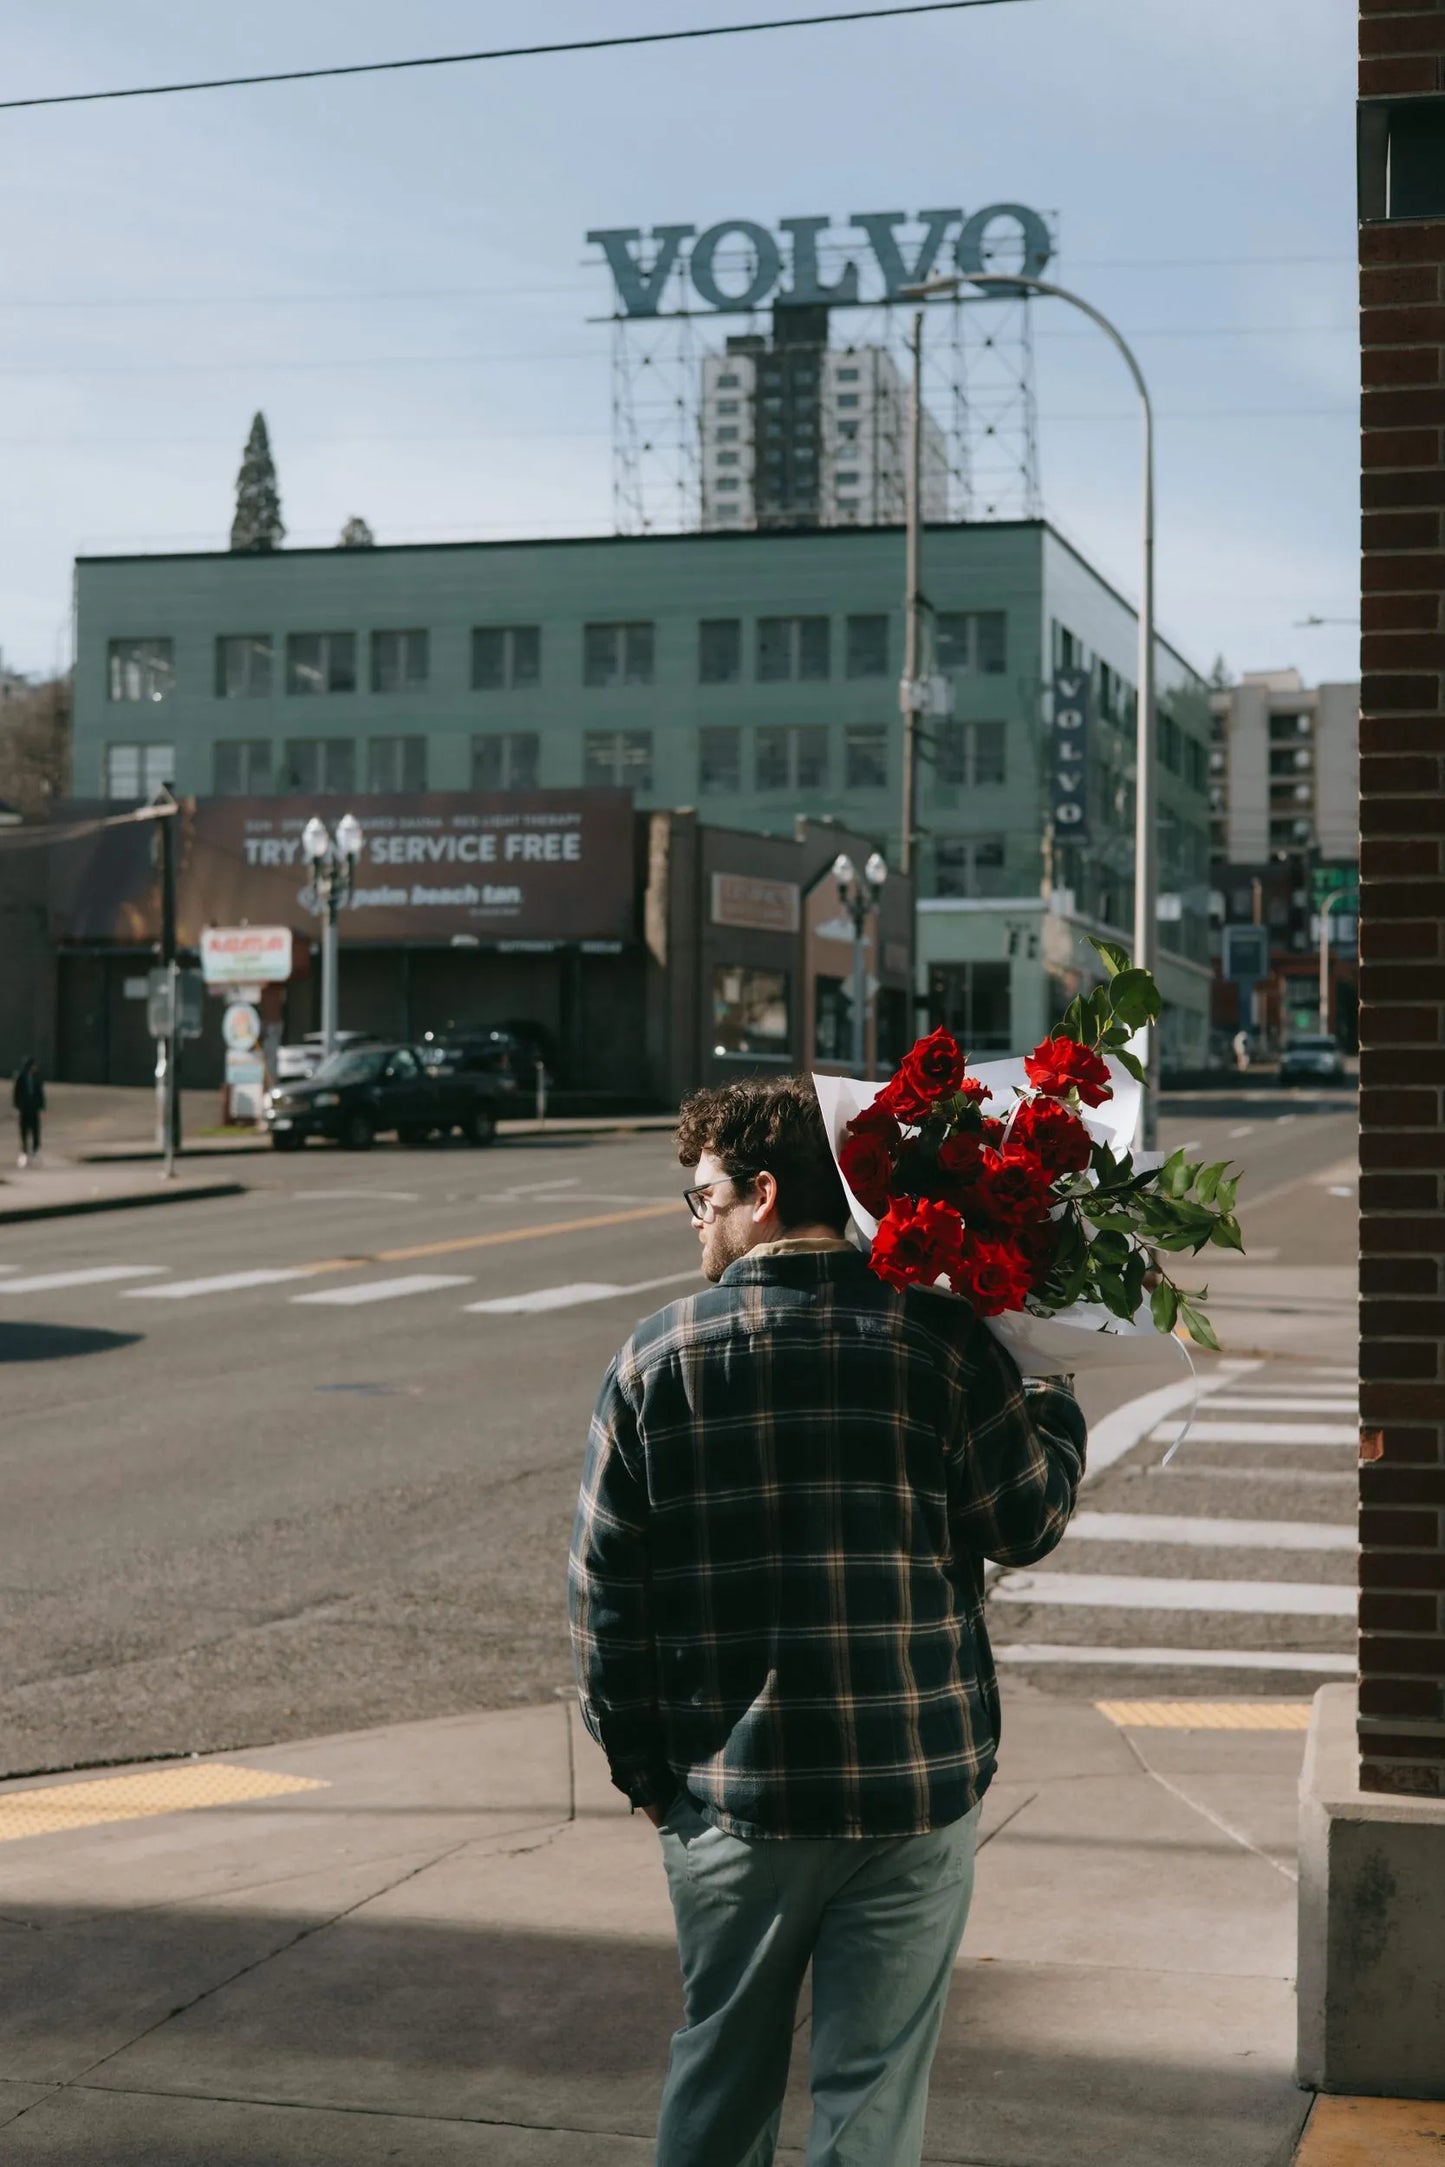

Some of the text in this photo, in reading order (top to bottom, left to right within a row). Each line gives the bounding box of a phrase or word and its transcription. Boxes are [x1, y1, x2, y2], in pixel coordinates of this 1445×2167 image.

[586, 203, 1051, 317] VOLVO
[1055, 677, 1084, 824] VOLVO
[244, 837, 298, 865] TRY
[371, 833, 497, 863] SERVICE
[505, 832, 582, 861] FREE
[351, 885, 408, 910] palm
[411, 883, 479, 906] beach
